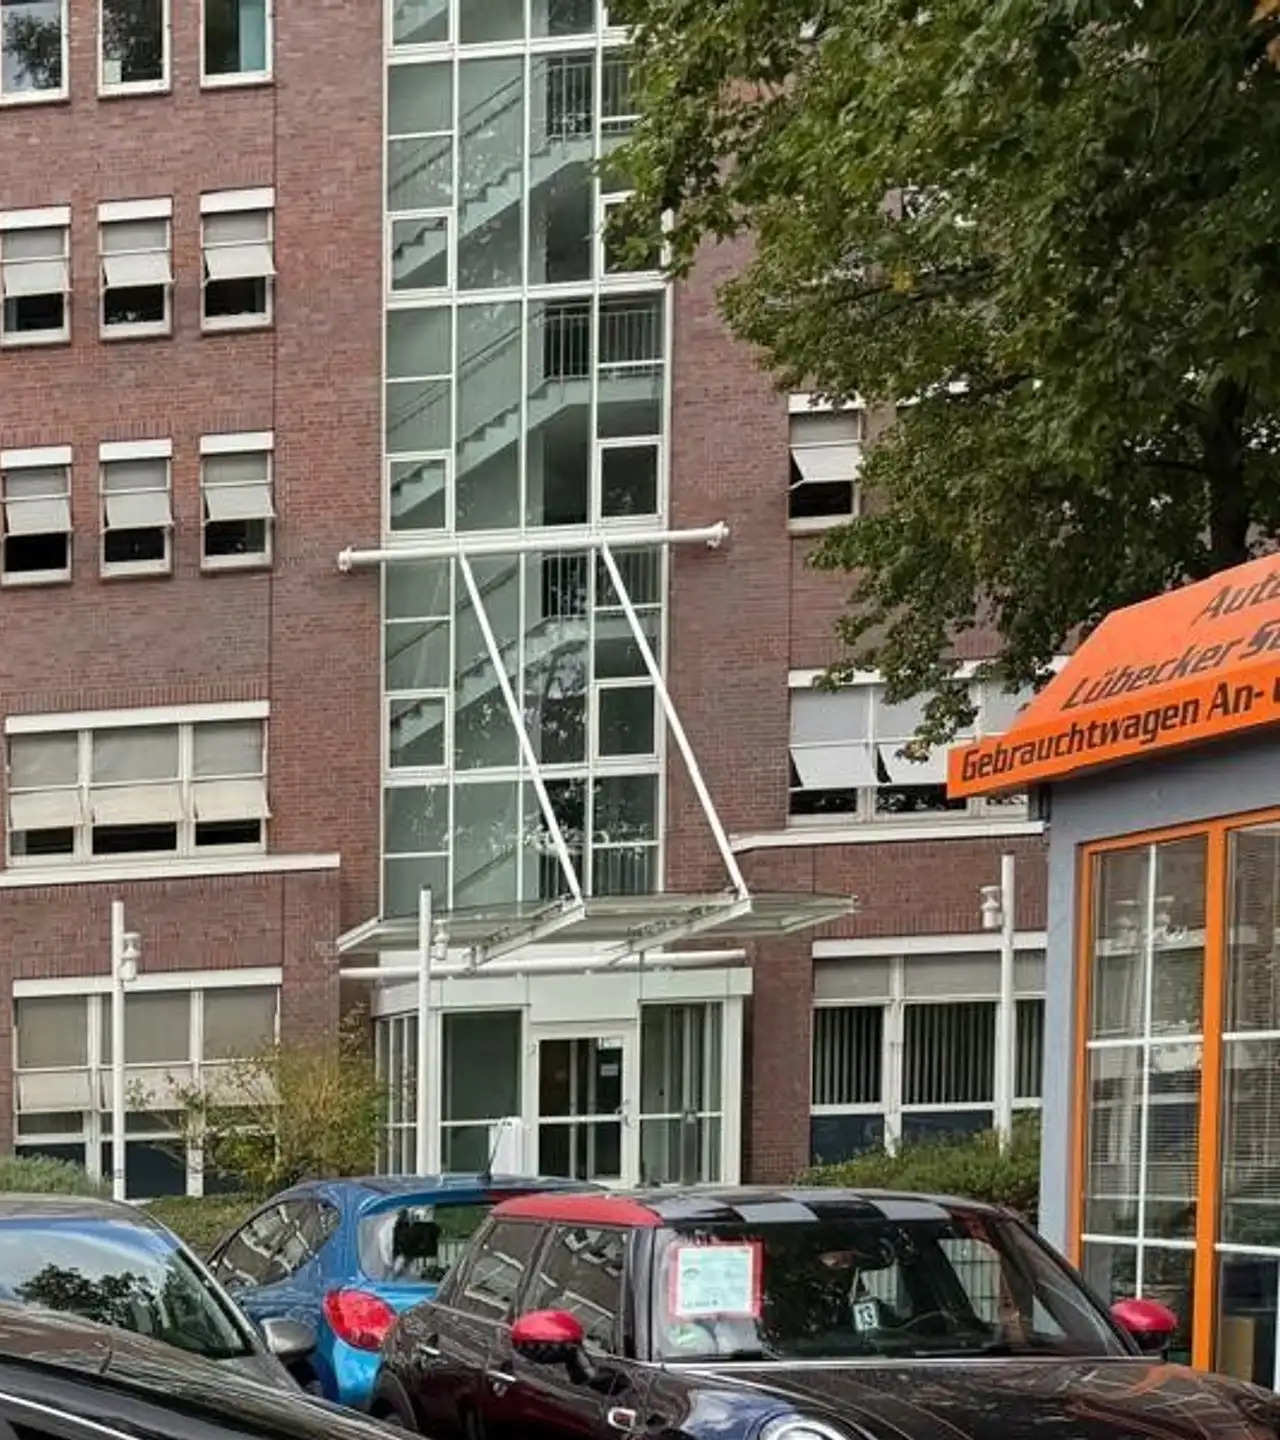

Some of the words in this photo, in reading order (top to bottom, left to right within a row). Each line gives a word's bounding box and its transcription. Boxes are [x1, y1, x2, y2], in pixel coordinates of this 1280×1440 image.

[1060, 638, 1243, 710] Lübecker
[961, 696, 1200, 782] Gebrauchtwagen
[1206, 681, 1264, 721] An-
